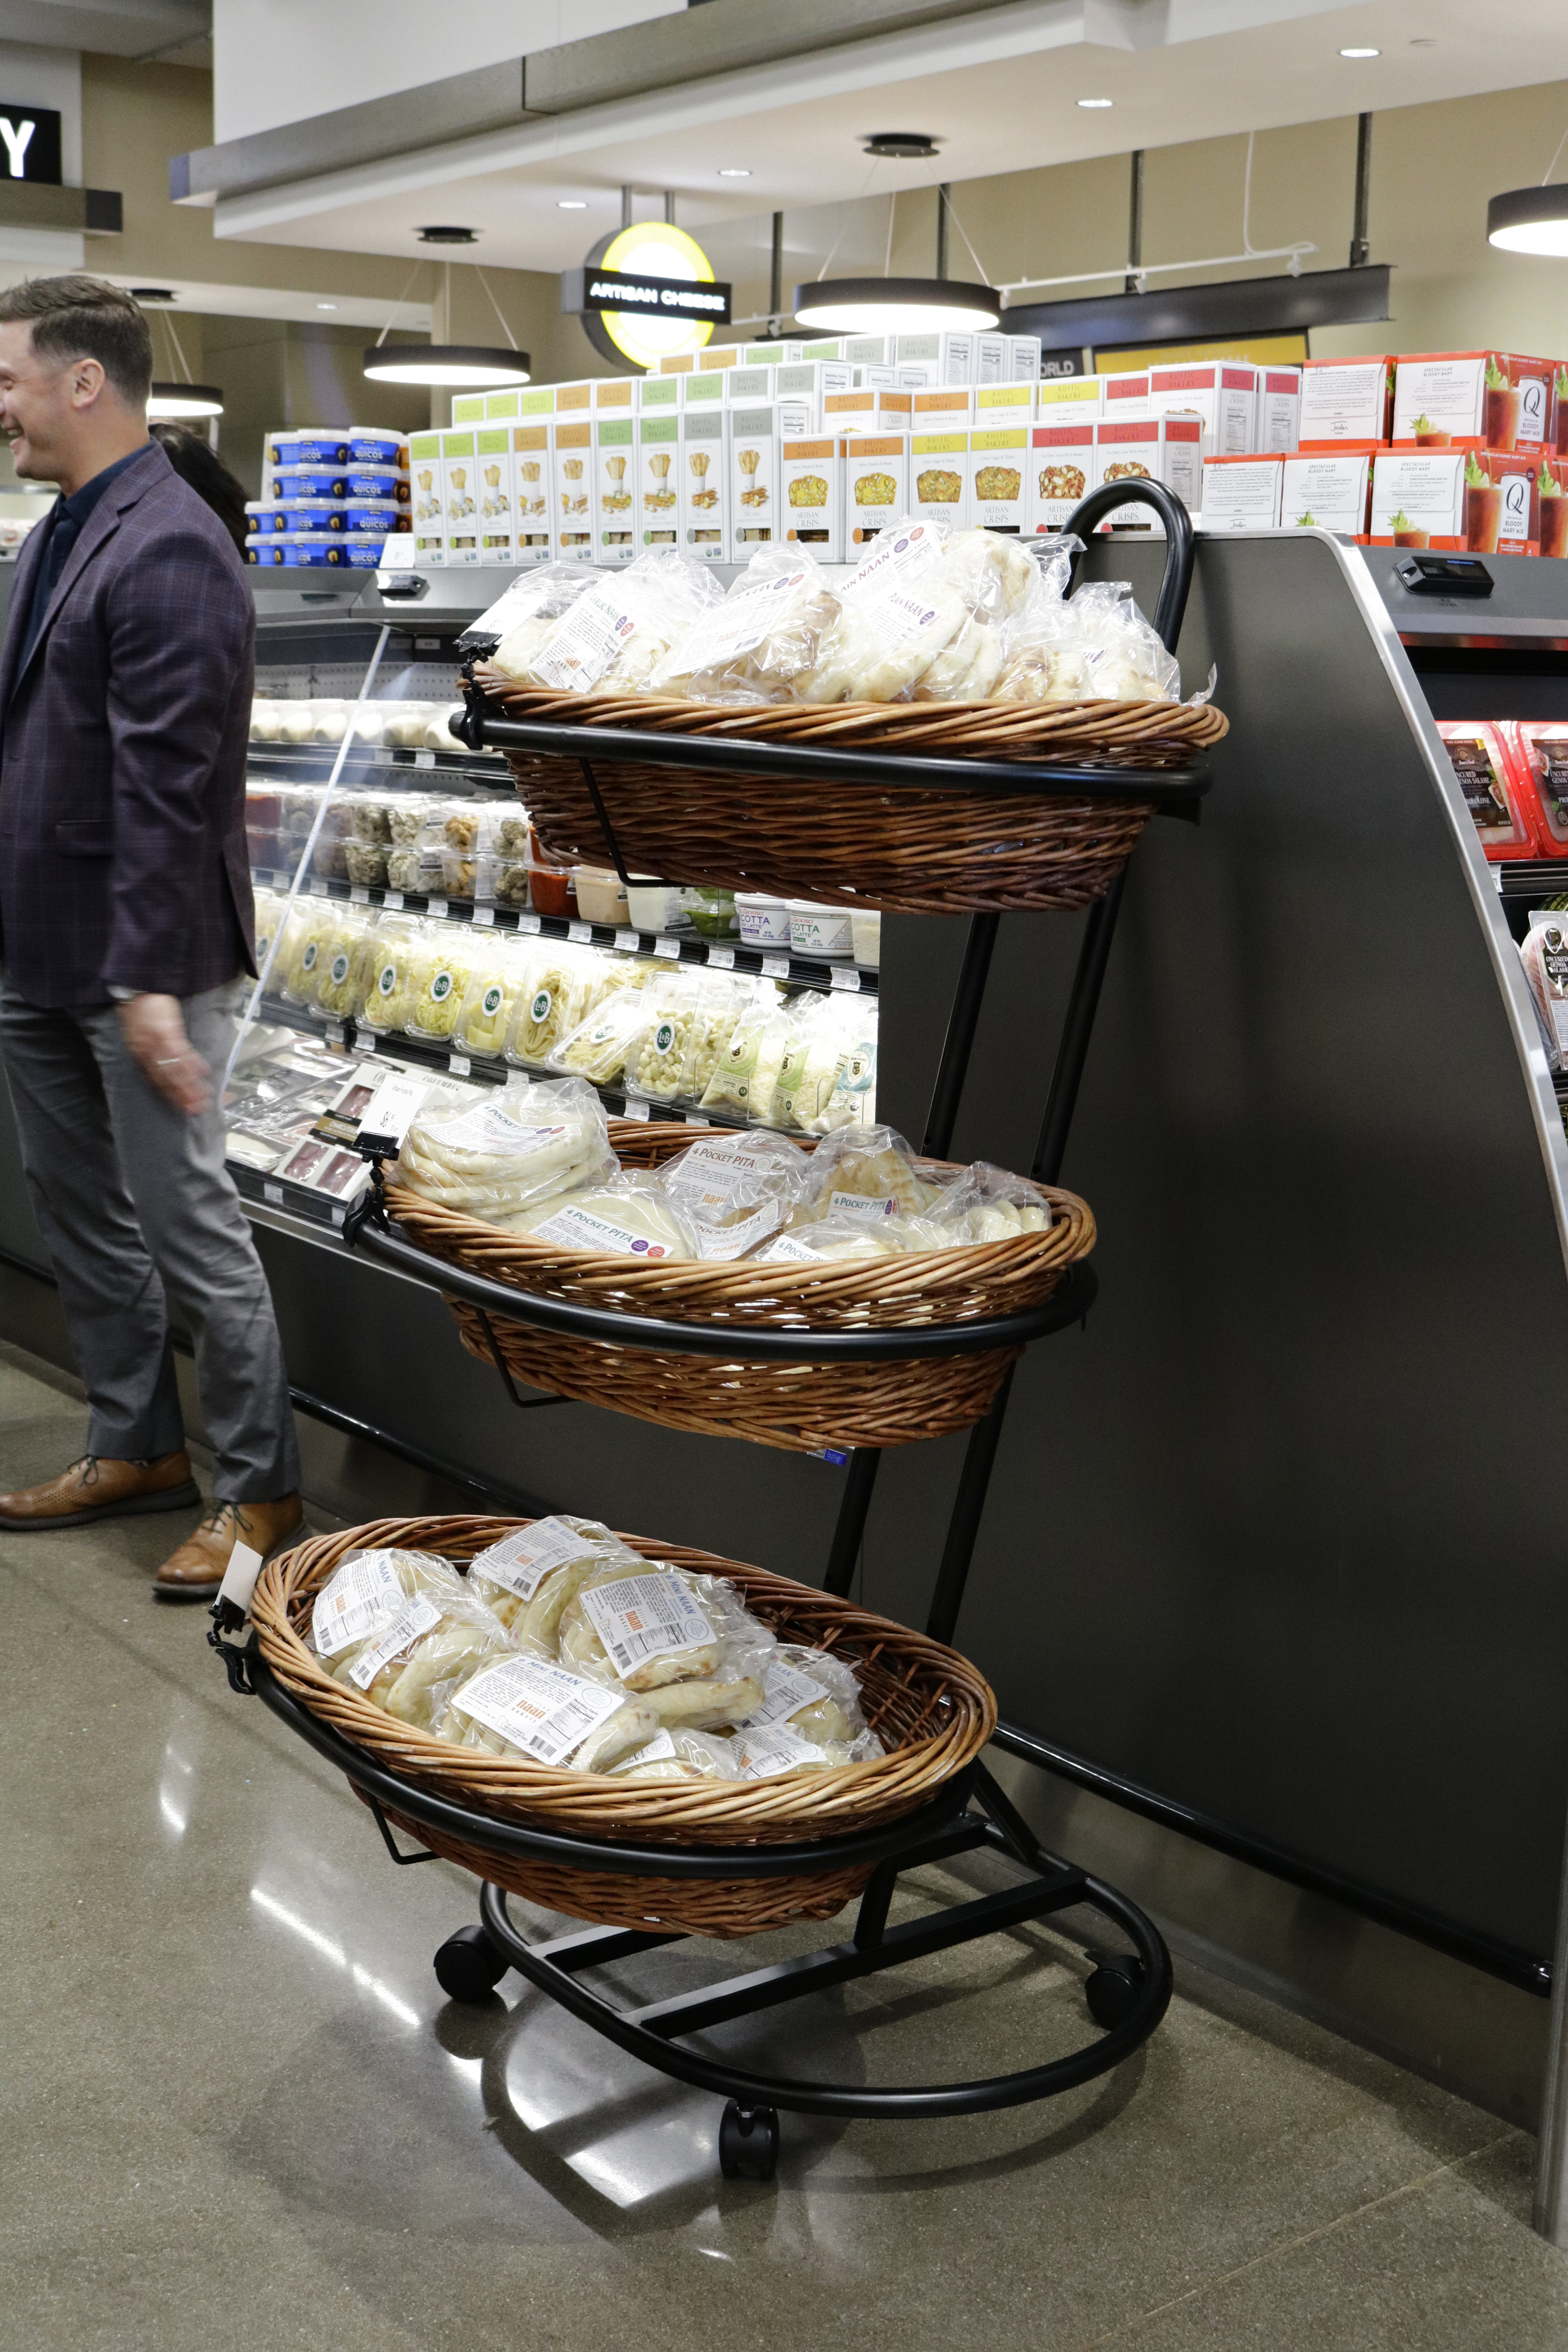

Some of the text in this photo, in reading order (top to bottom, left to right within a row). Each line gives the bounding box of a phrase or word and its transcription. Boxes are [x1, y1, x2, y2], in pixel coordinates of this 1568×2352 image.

[590, 282, 725, 311] ARTISAN CHEESE
[1041, 360, 1074, 377] ORLD
[1524, 386, 1540, 417] Q
[355, 450, 383, 459] QUICOS
[353, 486, 382, 494] QUICOS
[1506, 483, 1524, 514] Q
[984, 515, 1009, 523] CRISPS
[1112, 512, 1139, 521] CRISPS
[360, 521, 388, 529] QUICOS
[894, 550, 913, 565] Nutrition
[858, 552, 889, 580] NAAN
[589, 593, 621, 622] GARLIC NAAN
[887, 593, 926, 617] PLAIN NAAN
[741, 914, 770, 924] COTTA
[791, 922, 820, 933] COTTA
[435, 980, 447, 991] L&B
[486, 993, 498, 1007] L&B
[535, 1000, 546, 1012] L&B
[659, 1030, 670, 1044] L&B
[489, 1109, 519, 1128] POCKET
[699, 1148, 733, 1163] POCKET
[732, 1156, 755, 1168] PITA
[840, 1198, 870, 1209] POCKET
[869, 1201, 885, 1210] PITA
[573, 1212, 609, 1231] POCKET
[608, 1229, 633, 1243] PITA
[737, 1216, 760, 1231] PITA
[712, 1243, 741, 1252] naan
[784, 1245, 813, 1261] POCKET
[547, 1524, 559, 1532] MINI
[559, 1530, 578, 1541] NAAN
[378, 1560, 392, 1583] NAAN
[335, 1593, 346, 1614] naan
[669, 1581, 682, 1594] MINI
[678, 1596, 696, 1614] NAAN
[625, 1611, 643, 1631] naan
[527, 1662, 550, 1671] MINI
[550, 1669, 582, 1686] NAAN
[516, 1699, 546, 1719] naan
[574, 1698, 588, 1711] Nutrition
